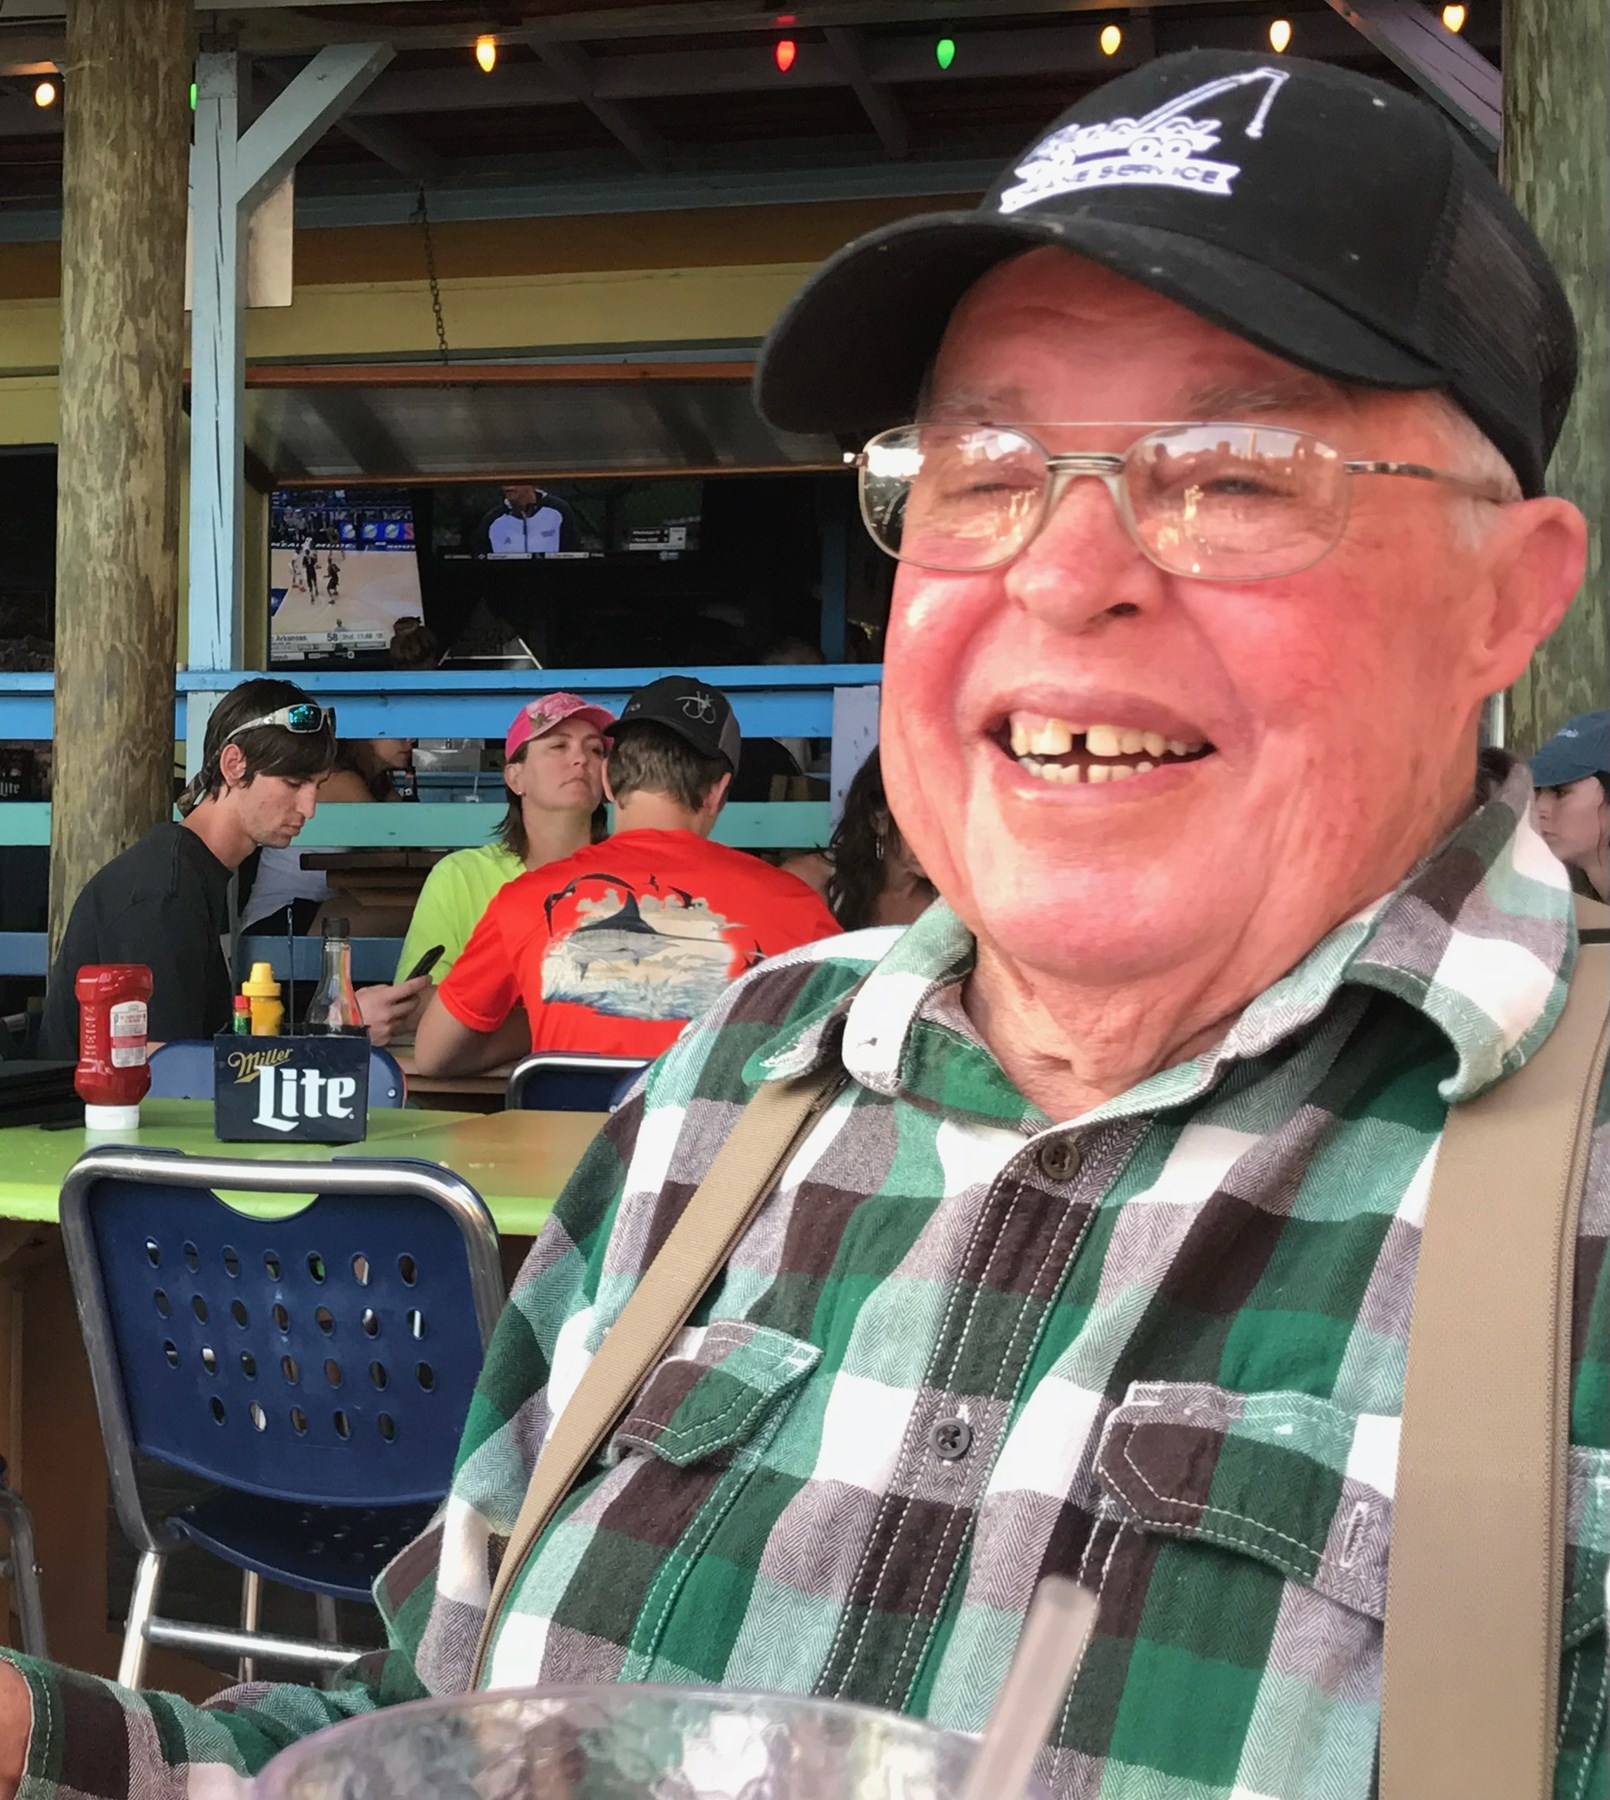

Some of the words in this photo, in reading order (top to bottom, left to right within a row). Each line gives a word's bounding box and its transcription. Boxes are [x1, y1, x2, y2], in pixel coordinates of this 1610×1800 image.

[327, 633, 339, 642] 58
[227, 1048, 294, 1081] Miller
[252, 1065, 356, 1132] Lite
